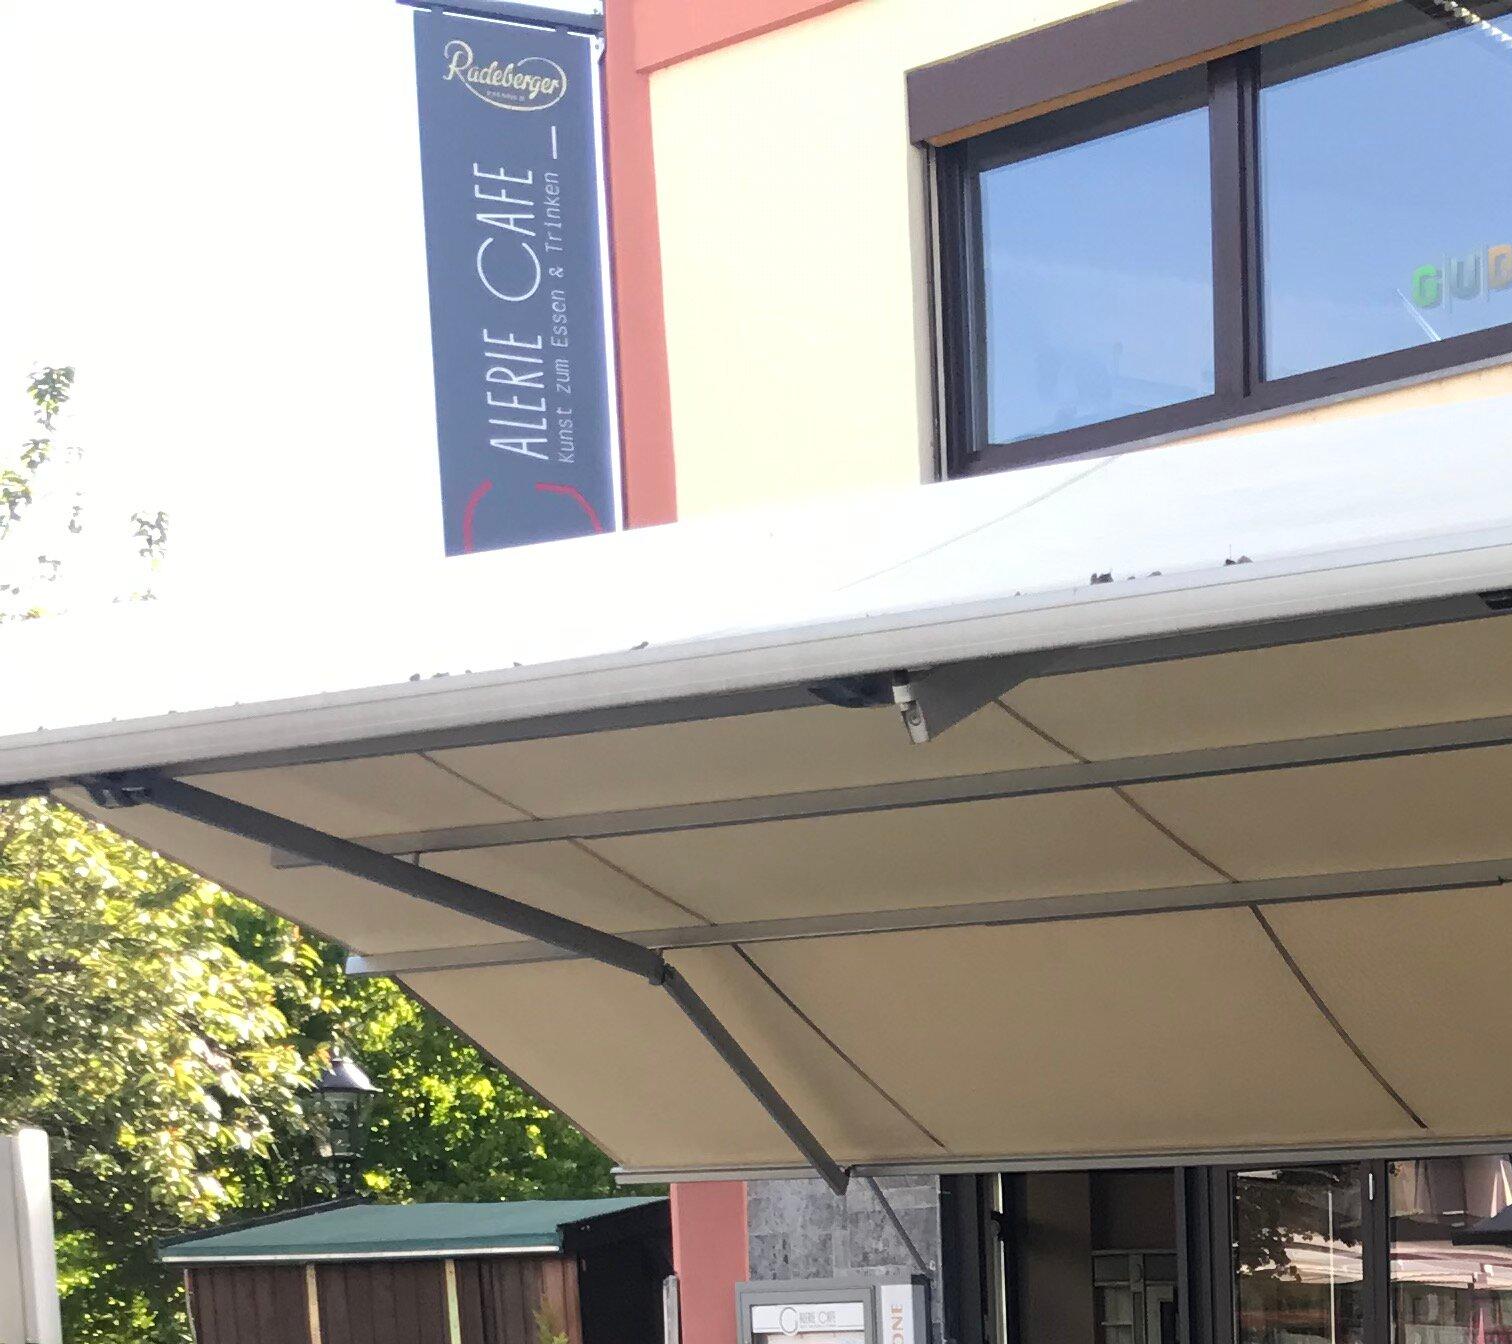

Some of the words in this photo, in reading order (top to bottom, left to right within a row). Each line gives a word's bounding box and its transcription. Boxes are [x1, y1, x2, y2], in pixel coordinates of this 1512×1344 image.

[443, 40, 567, 111] Radeberger
[473, 162, 542, 302] CAFE
[543, 172, 563, 252] Trinken
[548, 266, 564, 278] &
[550, 289, 568, 348] Essen
[555, 358, 571, 394] zum
[556, 407, 575, 463] Kunst
